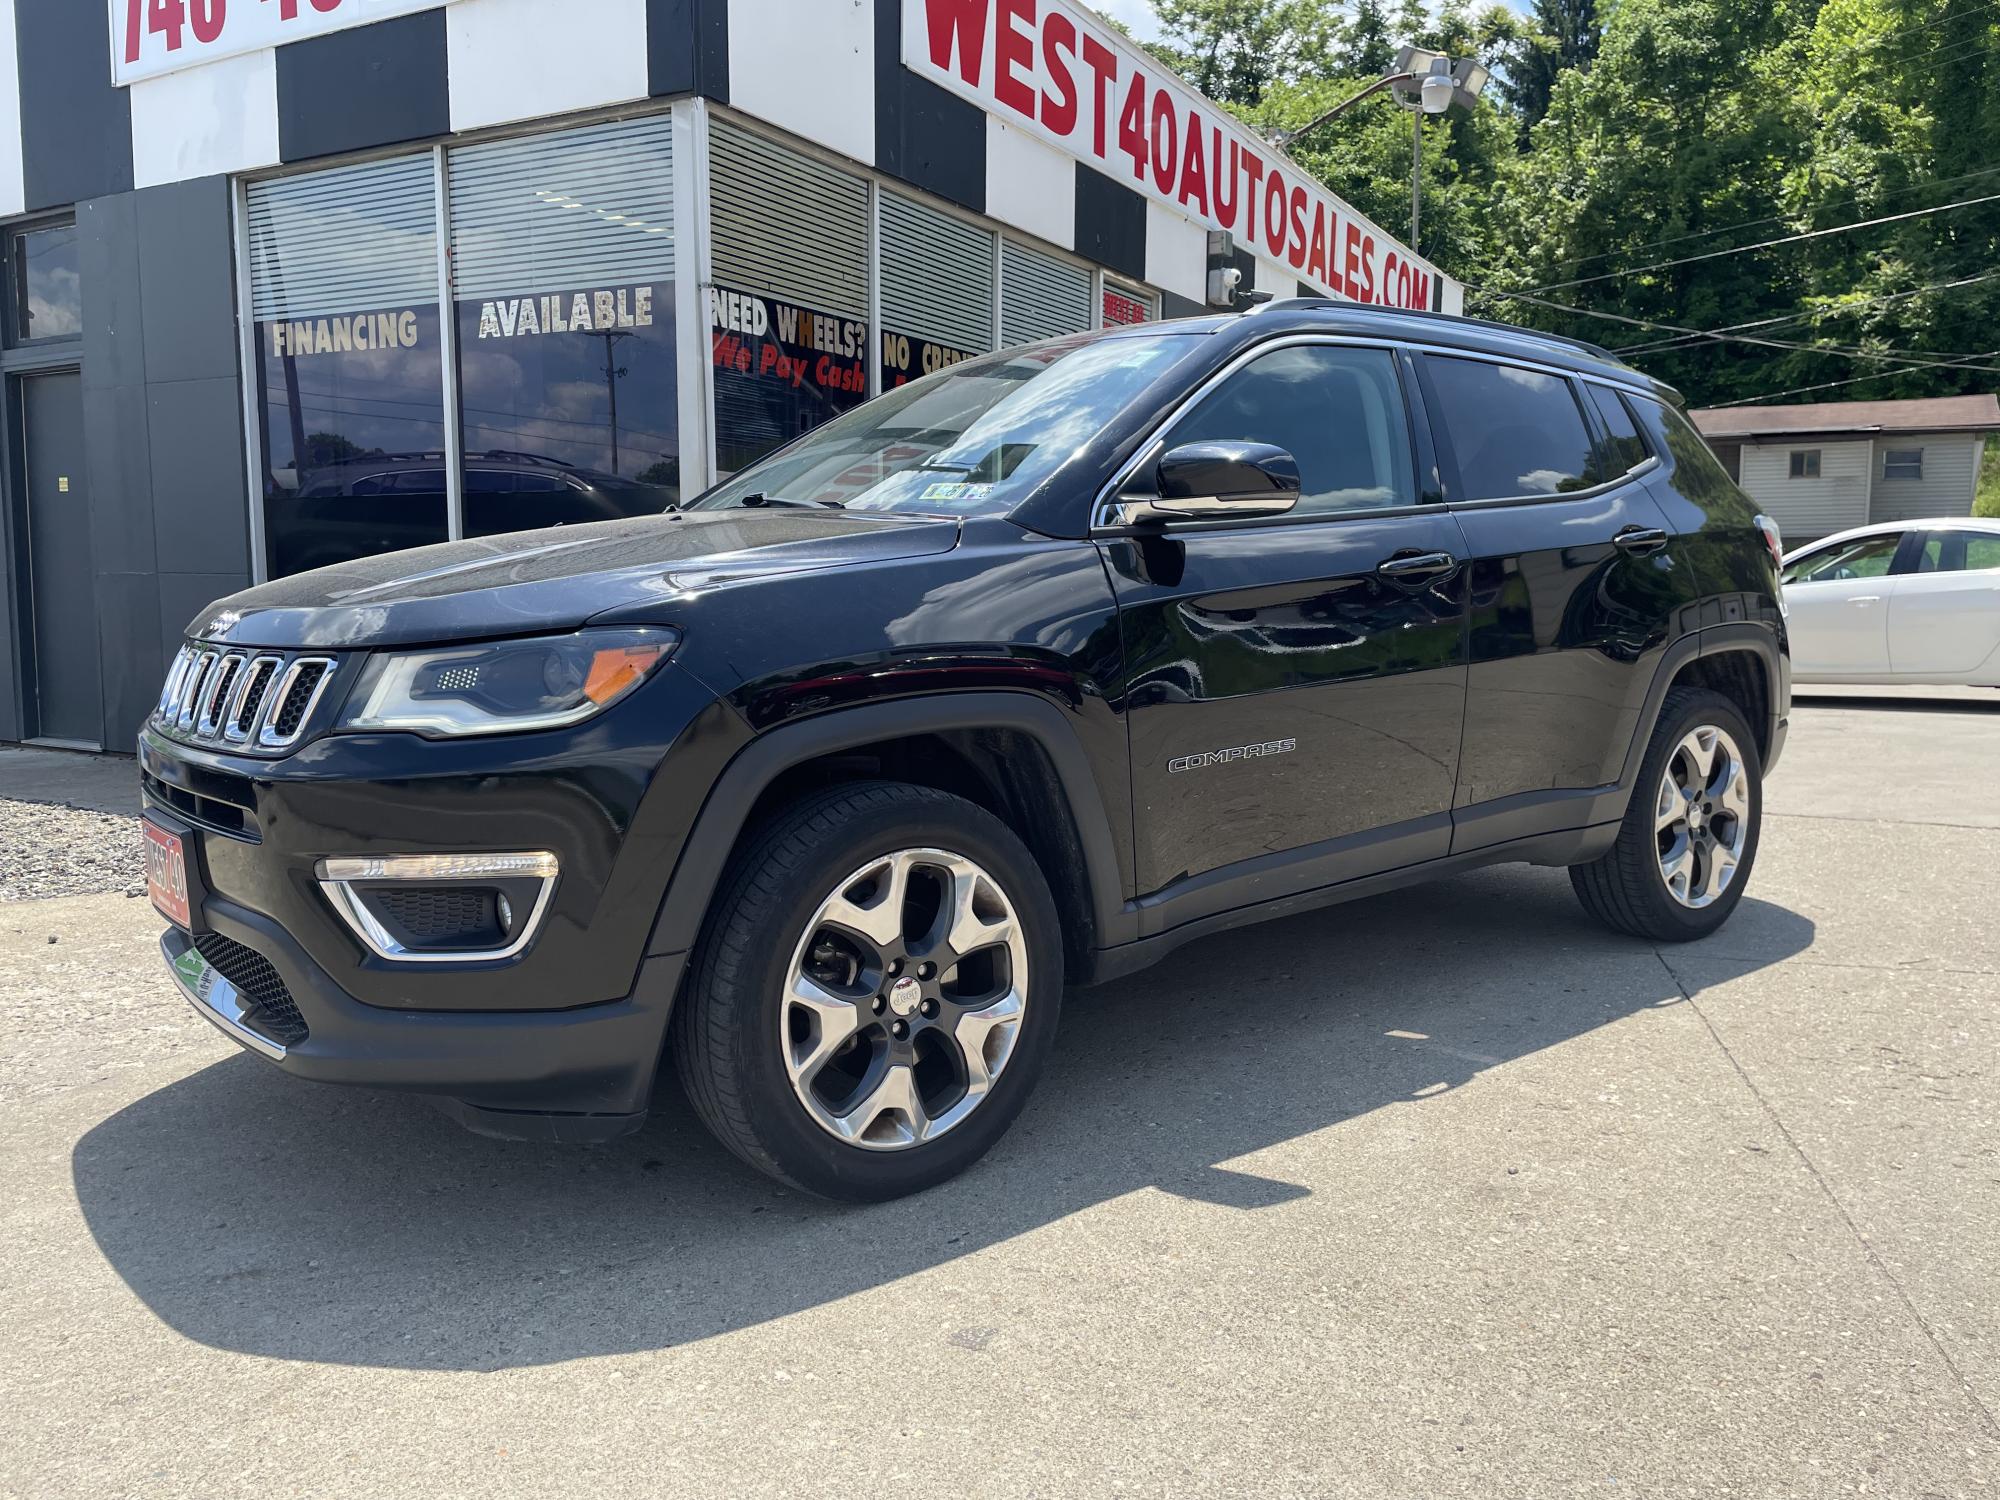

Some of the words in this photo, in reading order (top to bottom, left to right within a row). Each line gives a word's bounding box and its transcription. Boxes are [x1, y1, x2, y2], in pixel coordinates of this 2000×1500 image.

[273, 311, 417, 357] FINANCING
[478, 286, 653, 339] AVAILABLE
[712, 287, 768, 337] NEED
[776, 304, 866, 360] WHEELS?
[712, 332, 751, 373] We
[760, 343, 808, 388] Pay
[815, 355, 865, 393] Cash
[884, 332, 910, 370] NO
[923, 343, 976, 375] CRE
[1168, 738, 1296, 773] COMPASS
[894, 987, 918, 1006] Jeep
